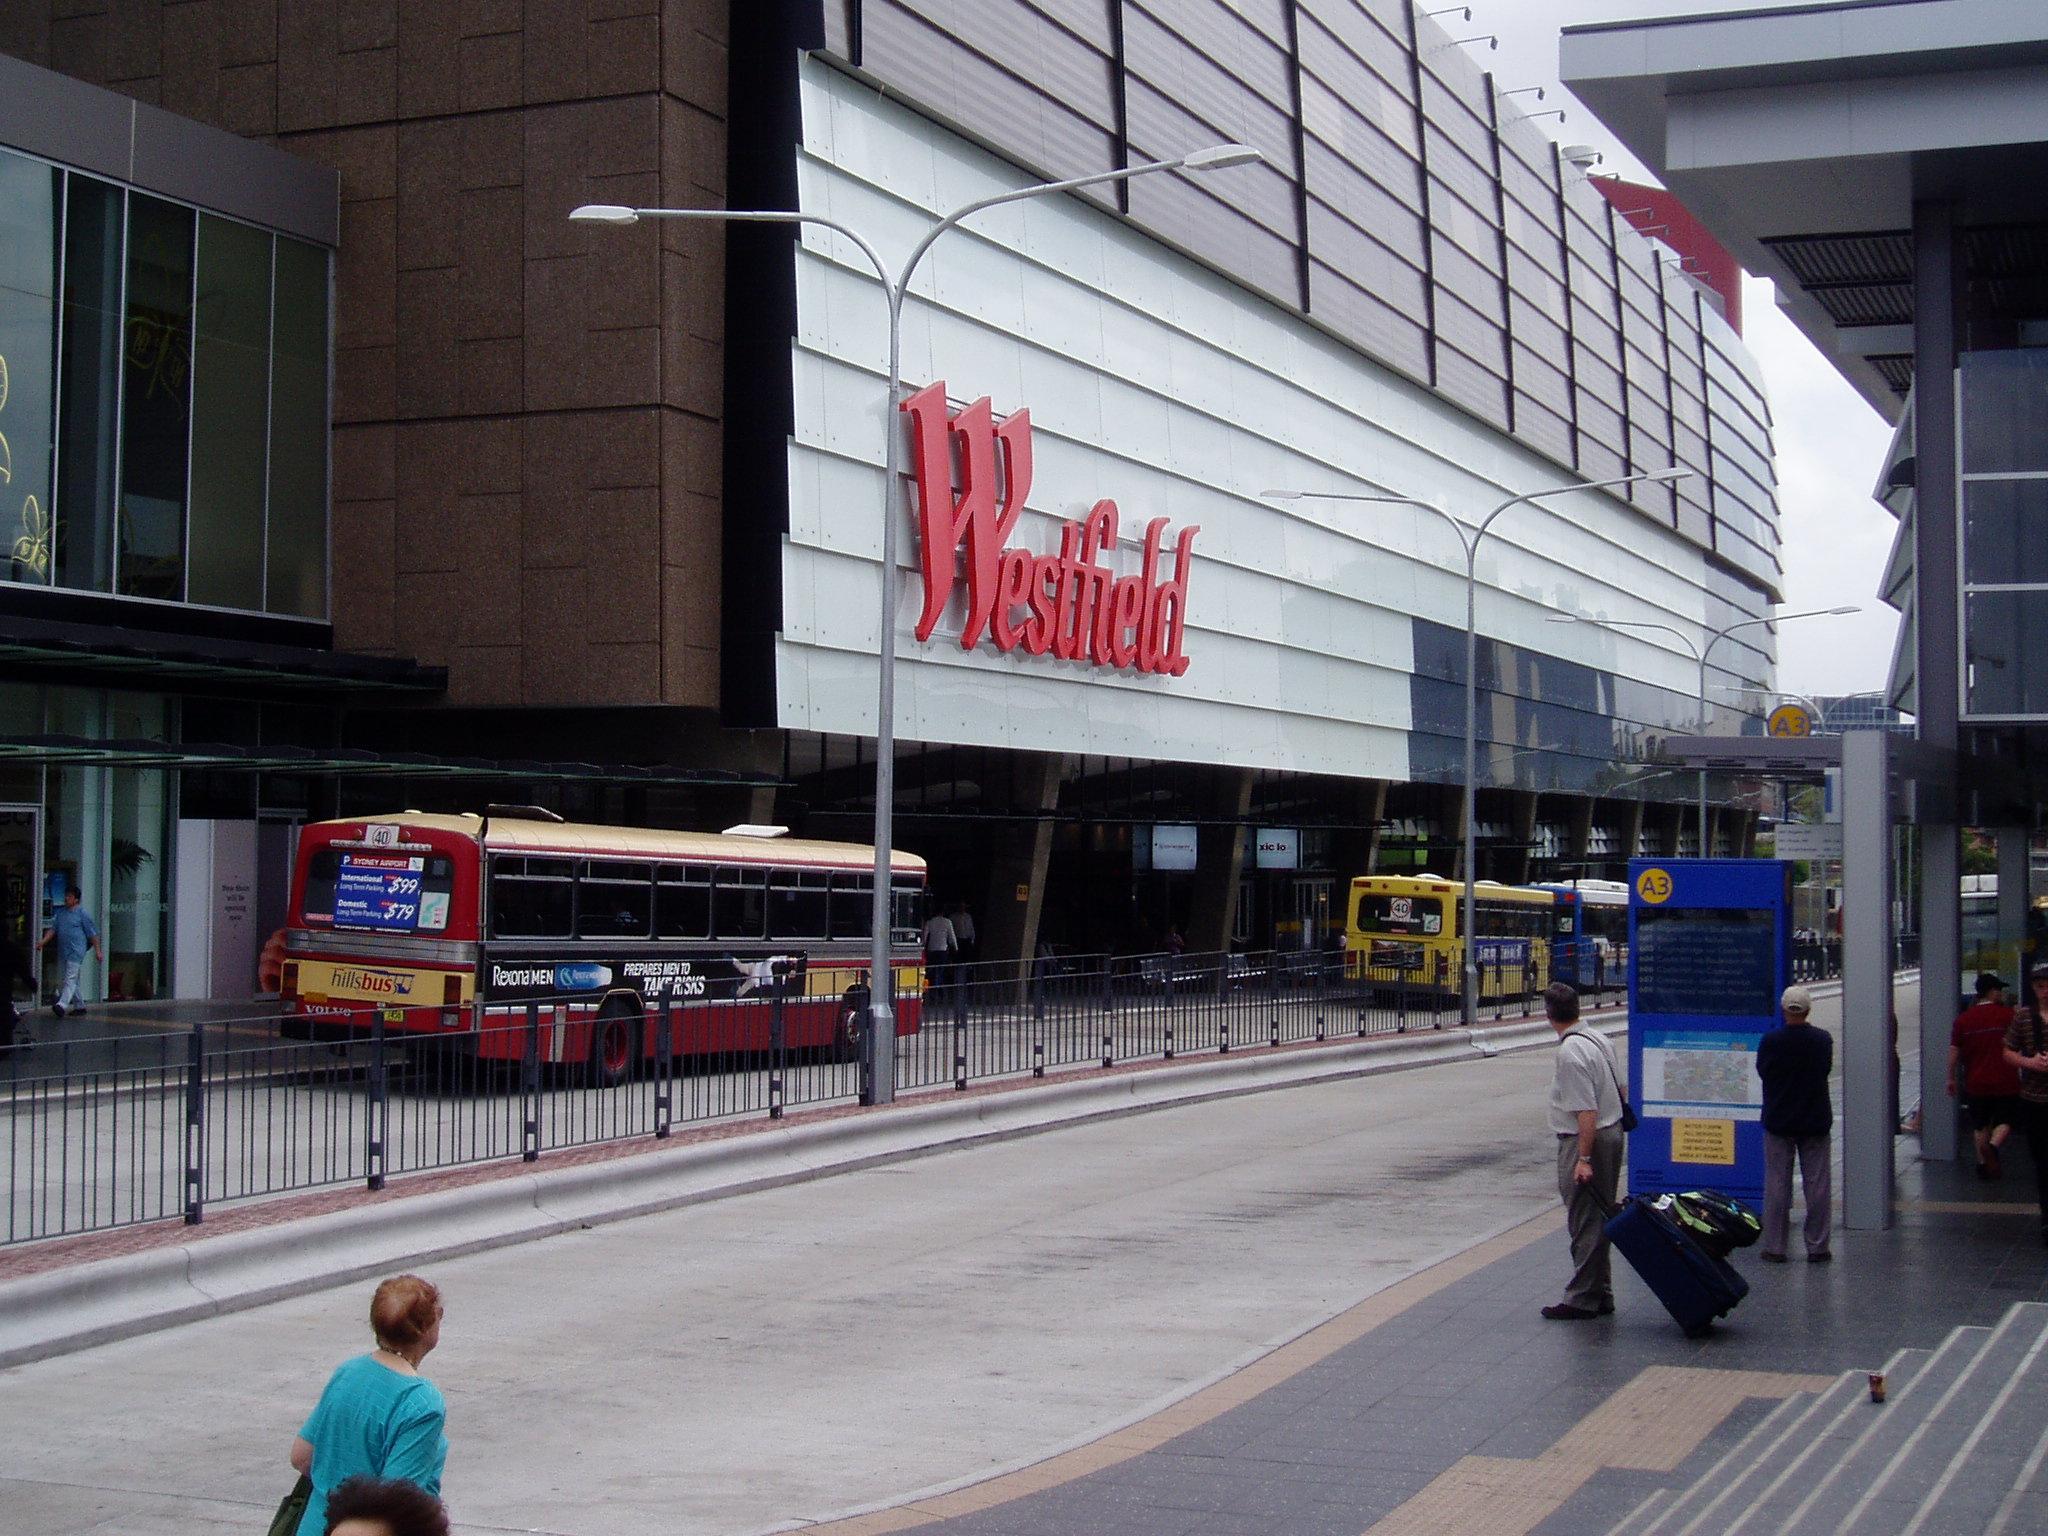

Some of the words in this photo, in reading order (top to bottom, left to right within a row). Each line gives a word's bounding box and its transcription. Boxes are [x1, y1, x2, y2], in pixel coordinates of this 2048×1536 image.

[899, 379, 1200, 677] Westfield
[1776, 716, 1809, 737] A3
[374, 831, 389, 844] 40
[352, 858, 379, 866] SYDNEY
[380, 860, 407, 868] AIRPORT
[341, 873, 383, 883] International
[340, 883, 353, 891] Long
[366, 884, 385, 892] Parking
[1641, 876, 1670, 896] A3
[338, 899, 368, 908] Domestic
[1395, 903, 1409, 913] 40
[337, 909, 349, 917] Long
[362, 910, 382, 919] Parking
[492, 965, 529, 987] Rexona
[531, 969, 554, 985] MEN
[623, 962, 662, 977] PREPARES
[662, 962, 681, 976] MEN
[681, 962, 691, 975] TO
[331, 969, 393, 992] hillsbus
[672, 975, 706, 996] RISKS
[305, 1004, 352, 1017] VOLVO
